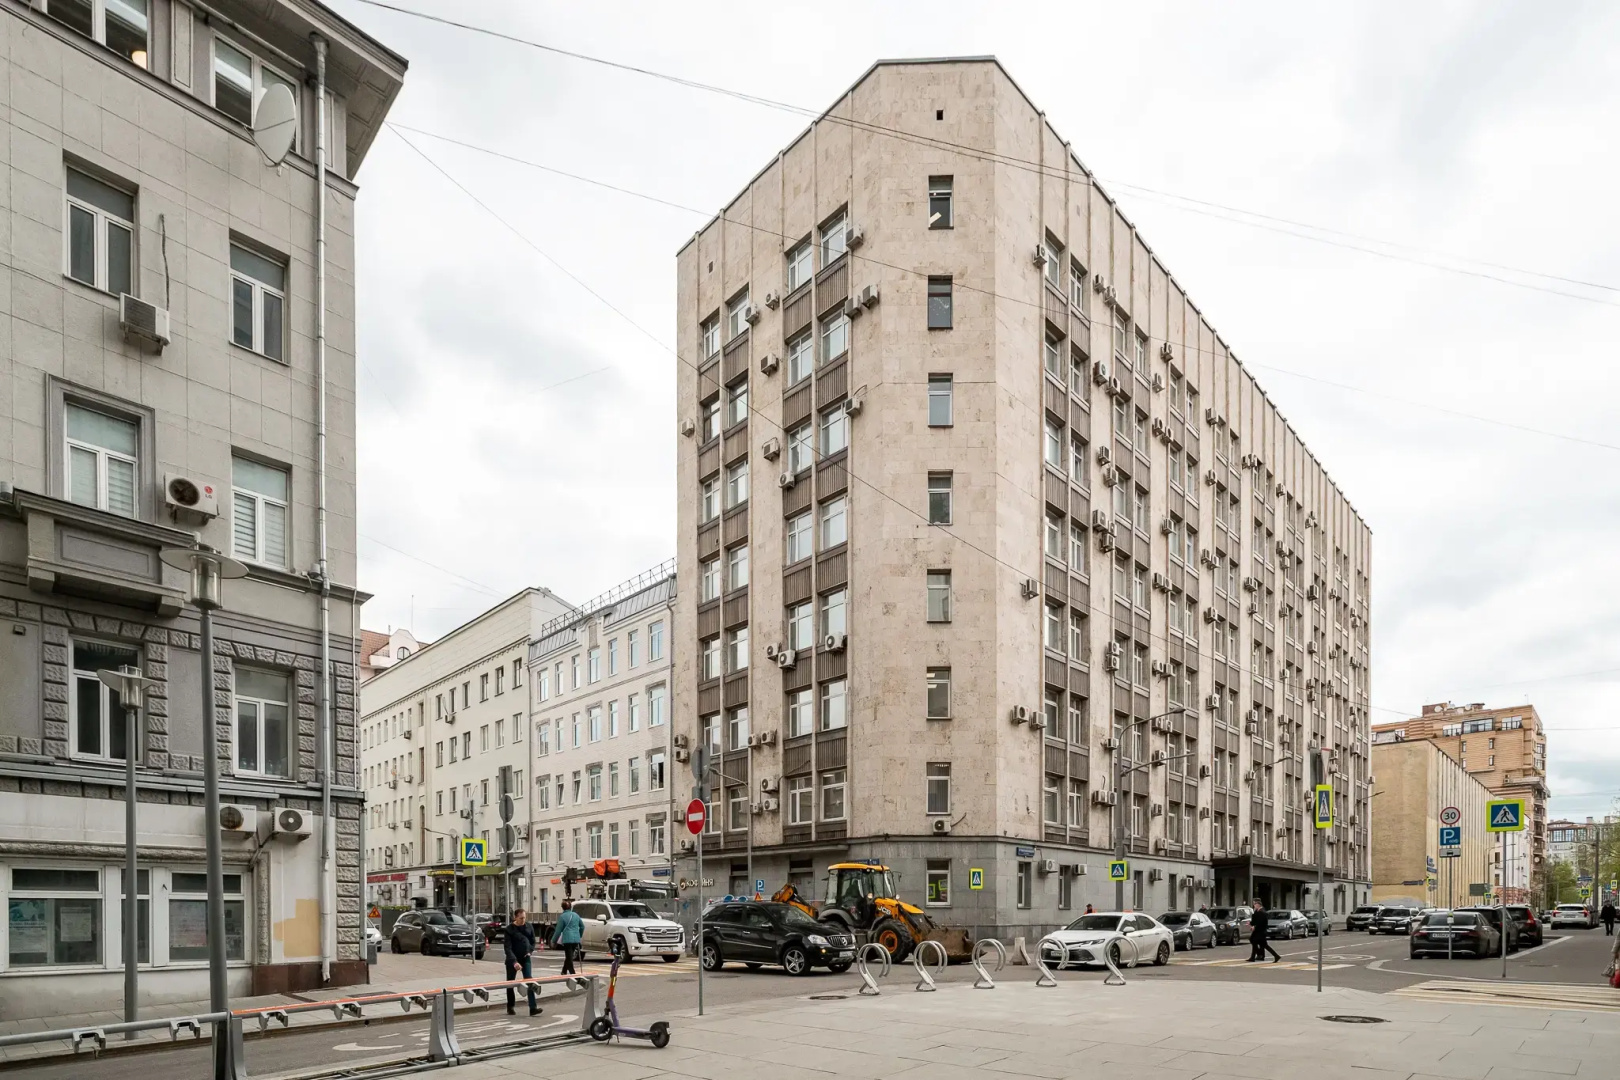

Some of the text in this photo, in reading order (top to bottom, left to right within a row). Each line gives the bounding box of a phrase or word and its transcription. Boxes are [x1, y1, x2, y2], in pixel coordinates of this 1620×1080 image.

[1444, 811, 1456, 820] 30
[1443, 829, 1455, 844] P
[685, 877, 714, 887] КОФЙНЯ
[757, 880, 763, 891] P
[878, 905, 892, 915] JCB
